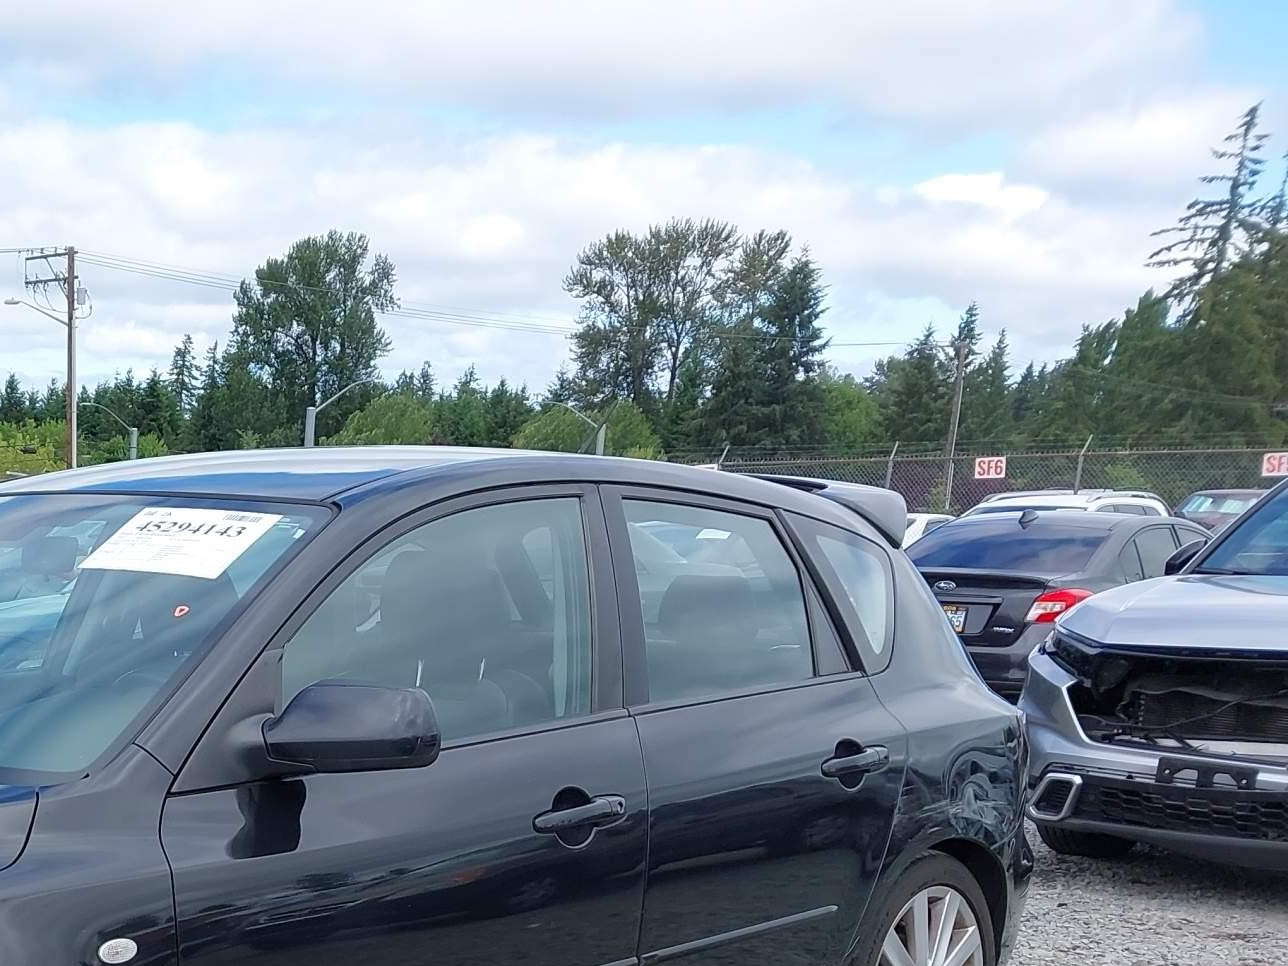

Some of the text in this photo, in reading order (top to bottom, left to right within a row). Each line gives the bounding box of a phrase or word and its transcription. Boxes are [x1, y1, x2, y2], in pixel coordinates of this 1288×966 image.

[978, 459, 1003, 476] SF6
[1266, 455, 1288, 473] SF
[135, 520, 247, 538] 45294143
